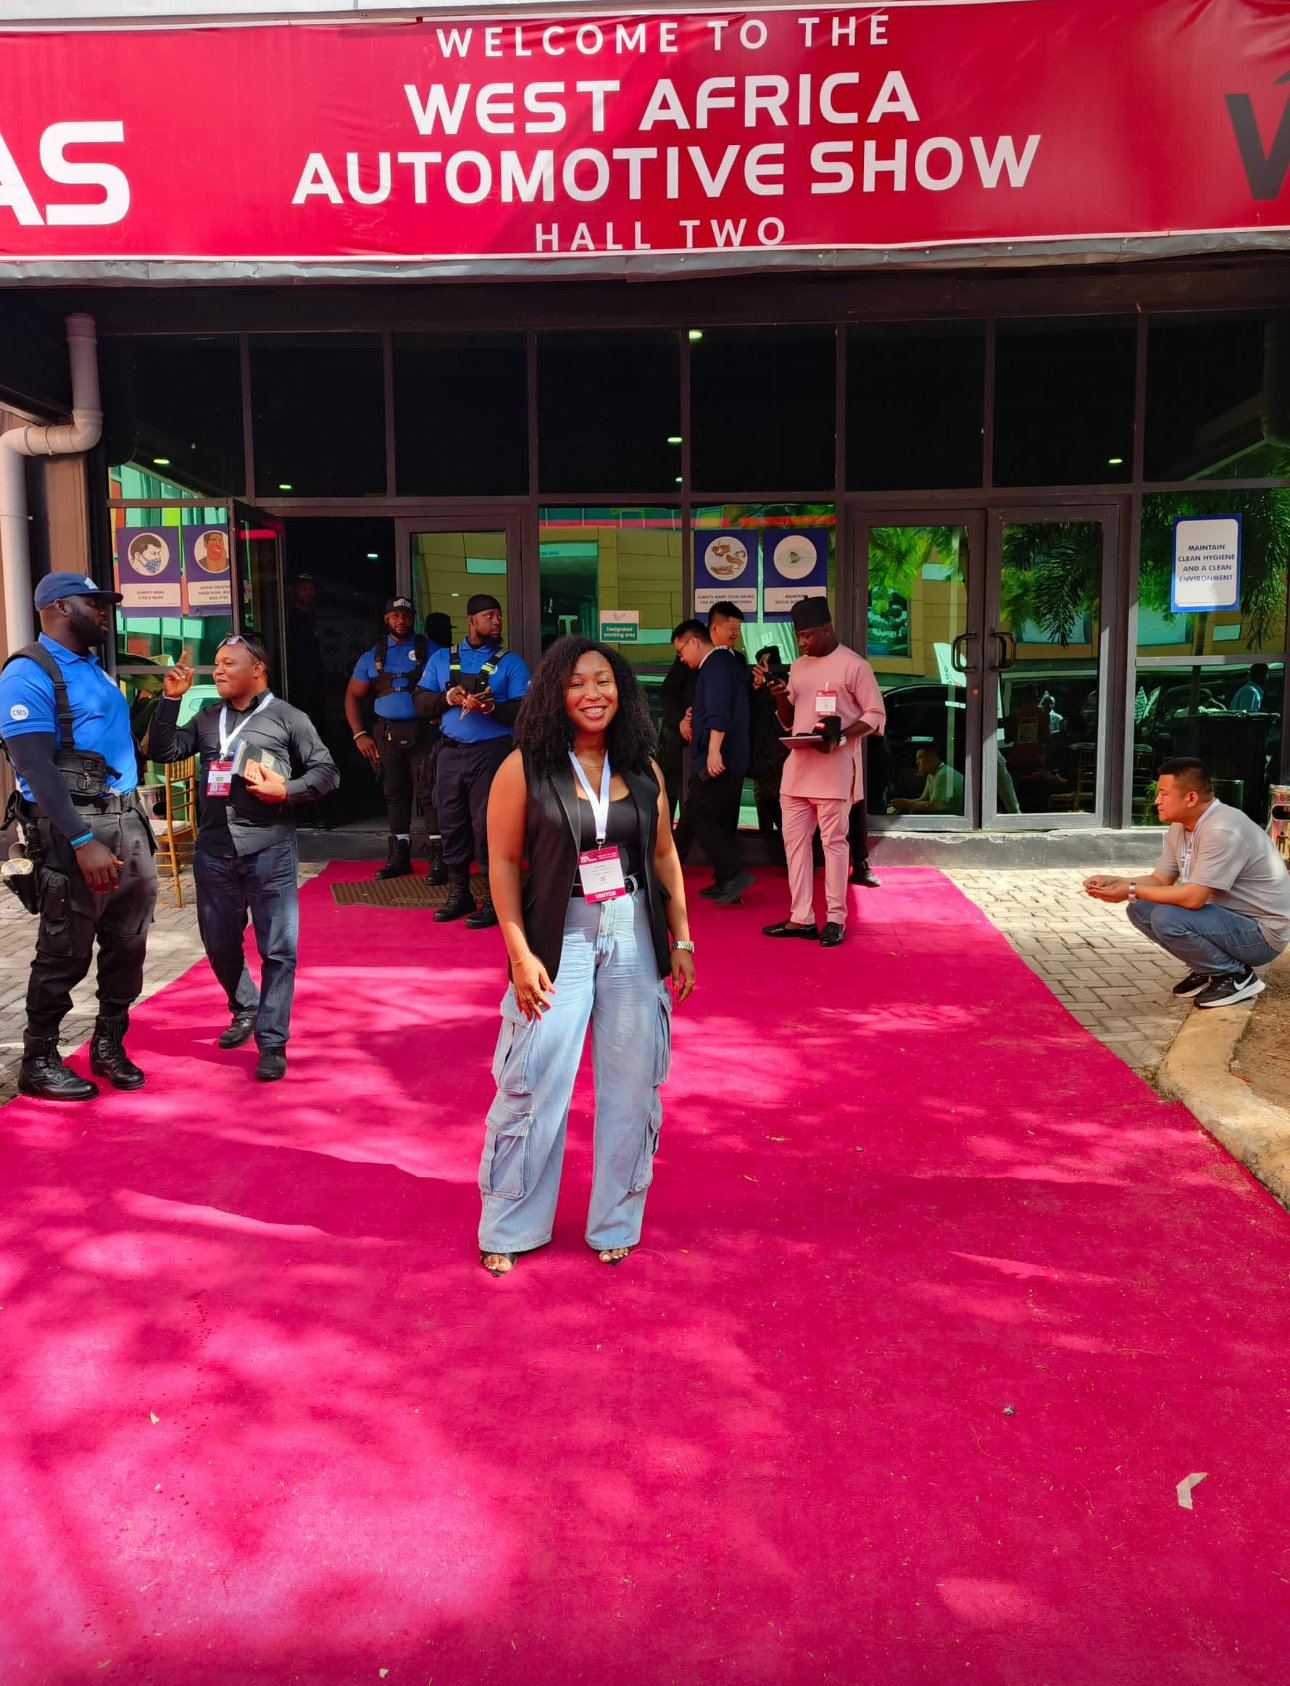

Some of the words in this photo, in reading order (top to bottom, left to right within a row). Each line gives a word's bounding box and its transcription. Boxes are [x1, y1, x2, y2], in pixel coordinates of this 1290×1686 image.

[437, 23, 677, 58] WELCOME
[706, 20, 768, 51] TO
[797, 15, 889, 47] THE
[404, 80, 621, 135] WEST
[639, 71, 920, 131] AFRICA
[292, 144, 785, 205] AUTOMOTIVE
[811, 135, 1041, 194] SHOW
[536, 221, 651, 251] HALL
[679, 217, 785, 248] TWO
[1179, 574, 1233, 582] ENVIRONMENT
[594, 890, 617, 899] VISITOR
